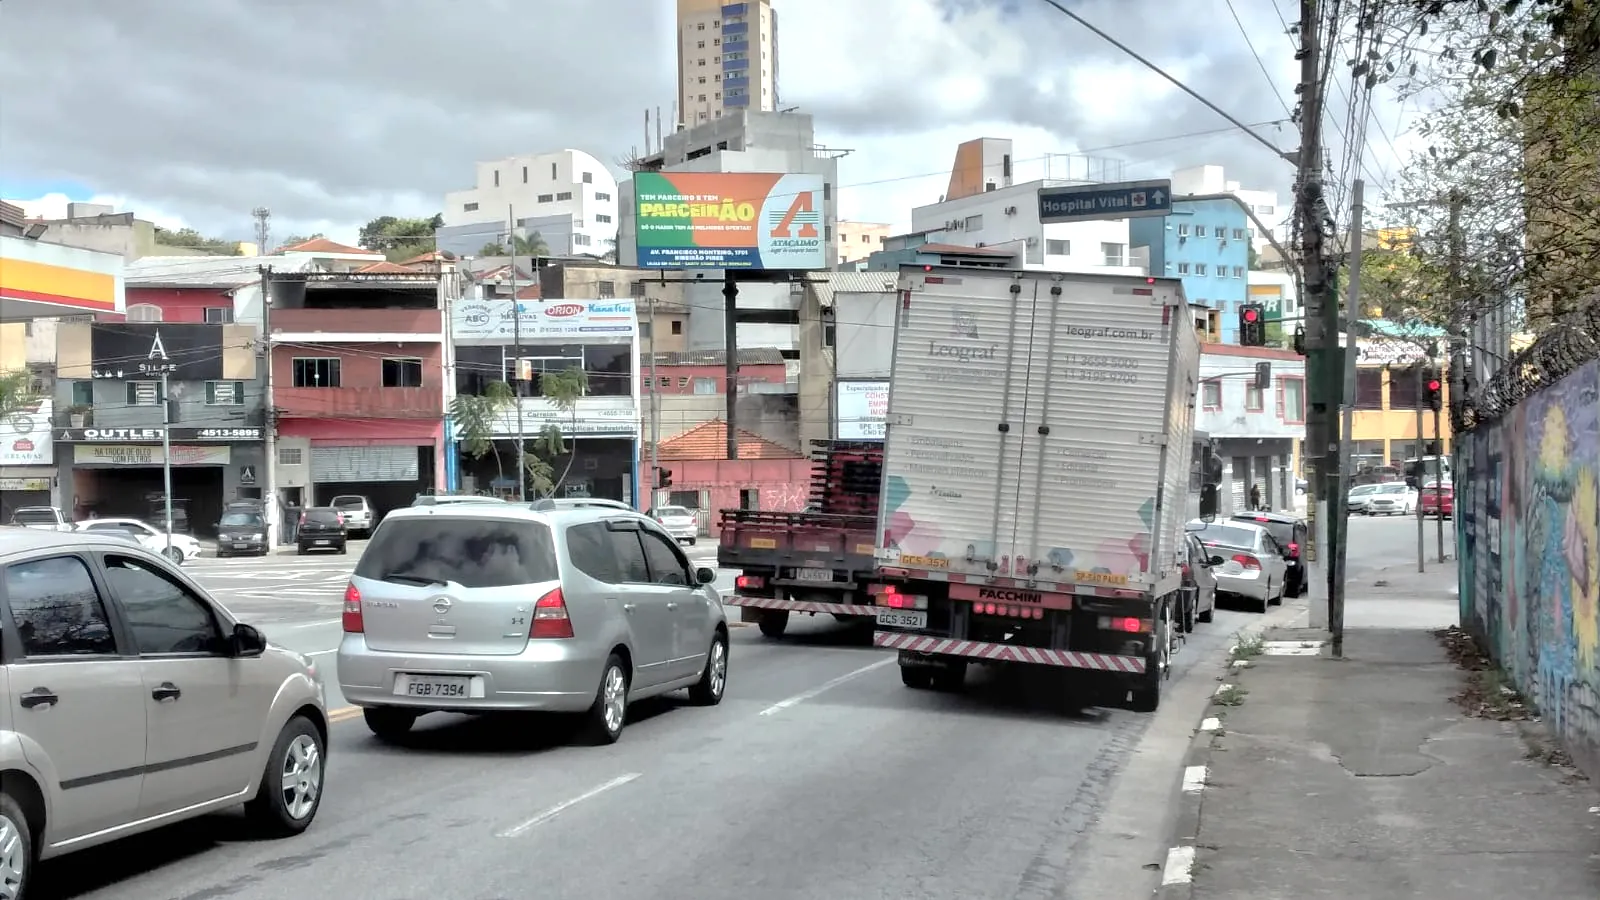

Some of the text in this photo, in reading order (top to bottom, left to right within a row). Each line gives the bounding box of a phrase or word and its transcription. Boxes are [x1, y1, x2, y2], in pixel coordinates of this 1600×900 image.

[640, 198, 755, 222] PARCEIRÃO
[1043, 195, 1128, 213] Hospital Vital
[547, 303, 582, 315] ORION
[465, 314, 486, 323] ABC
[1066, 325, 1154, 340] leograf.com.br
[927, 341, 998, 363] Leograf
[84, 429, 164, 438] OUTLET
[203, 429, 260, 437] 4513-5895
[979, 588, 1042, 603] FACCHINI
